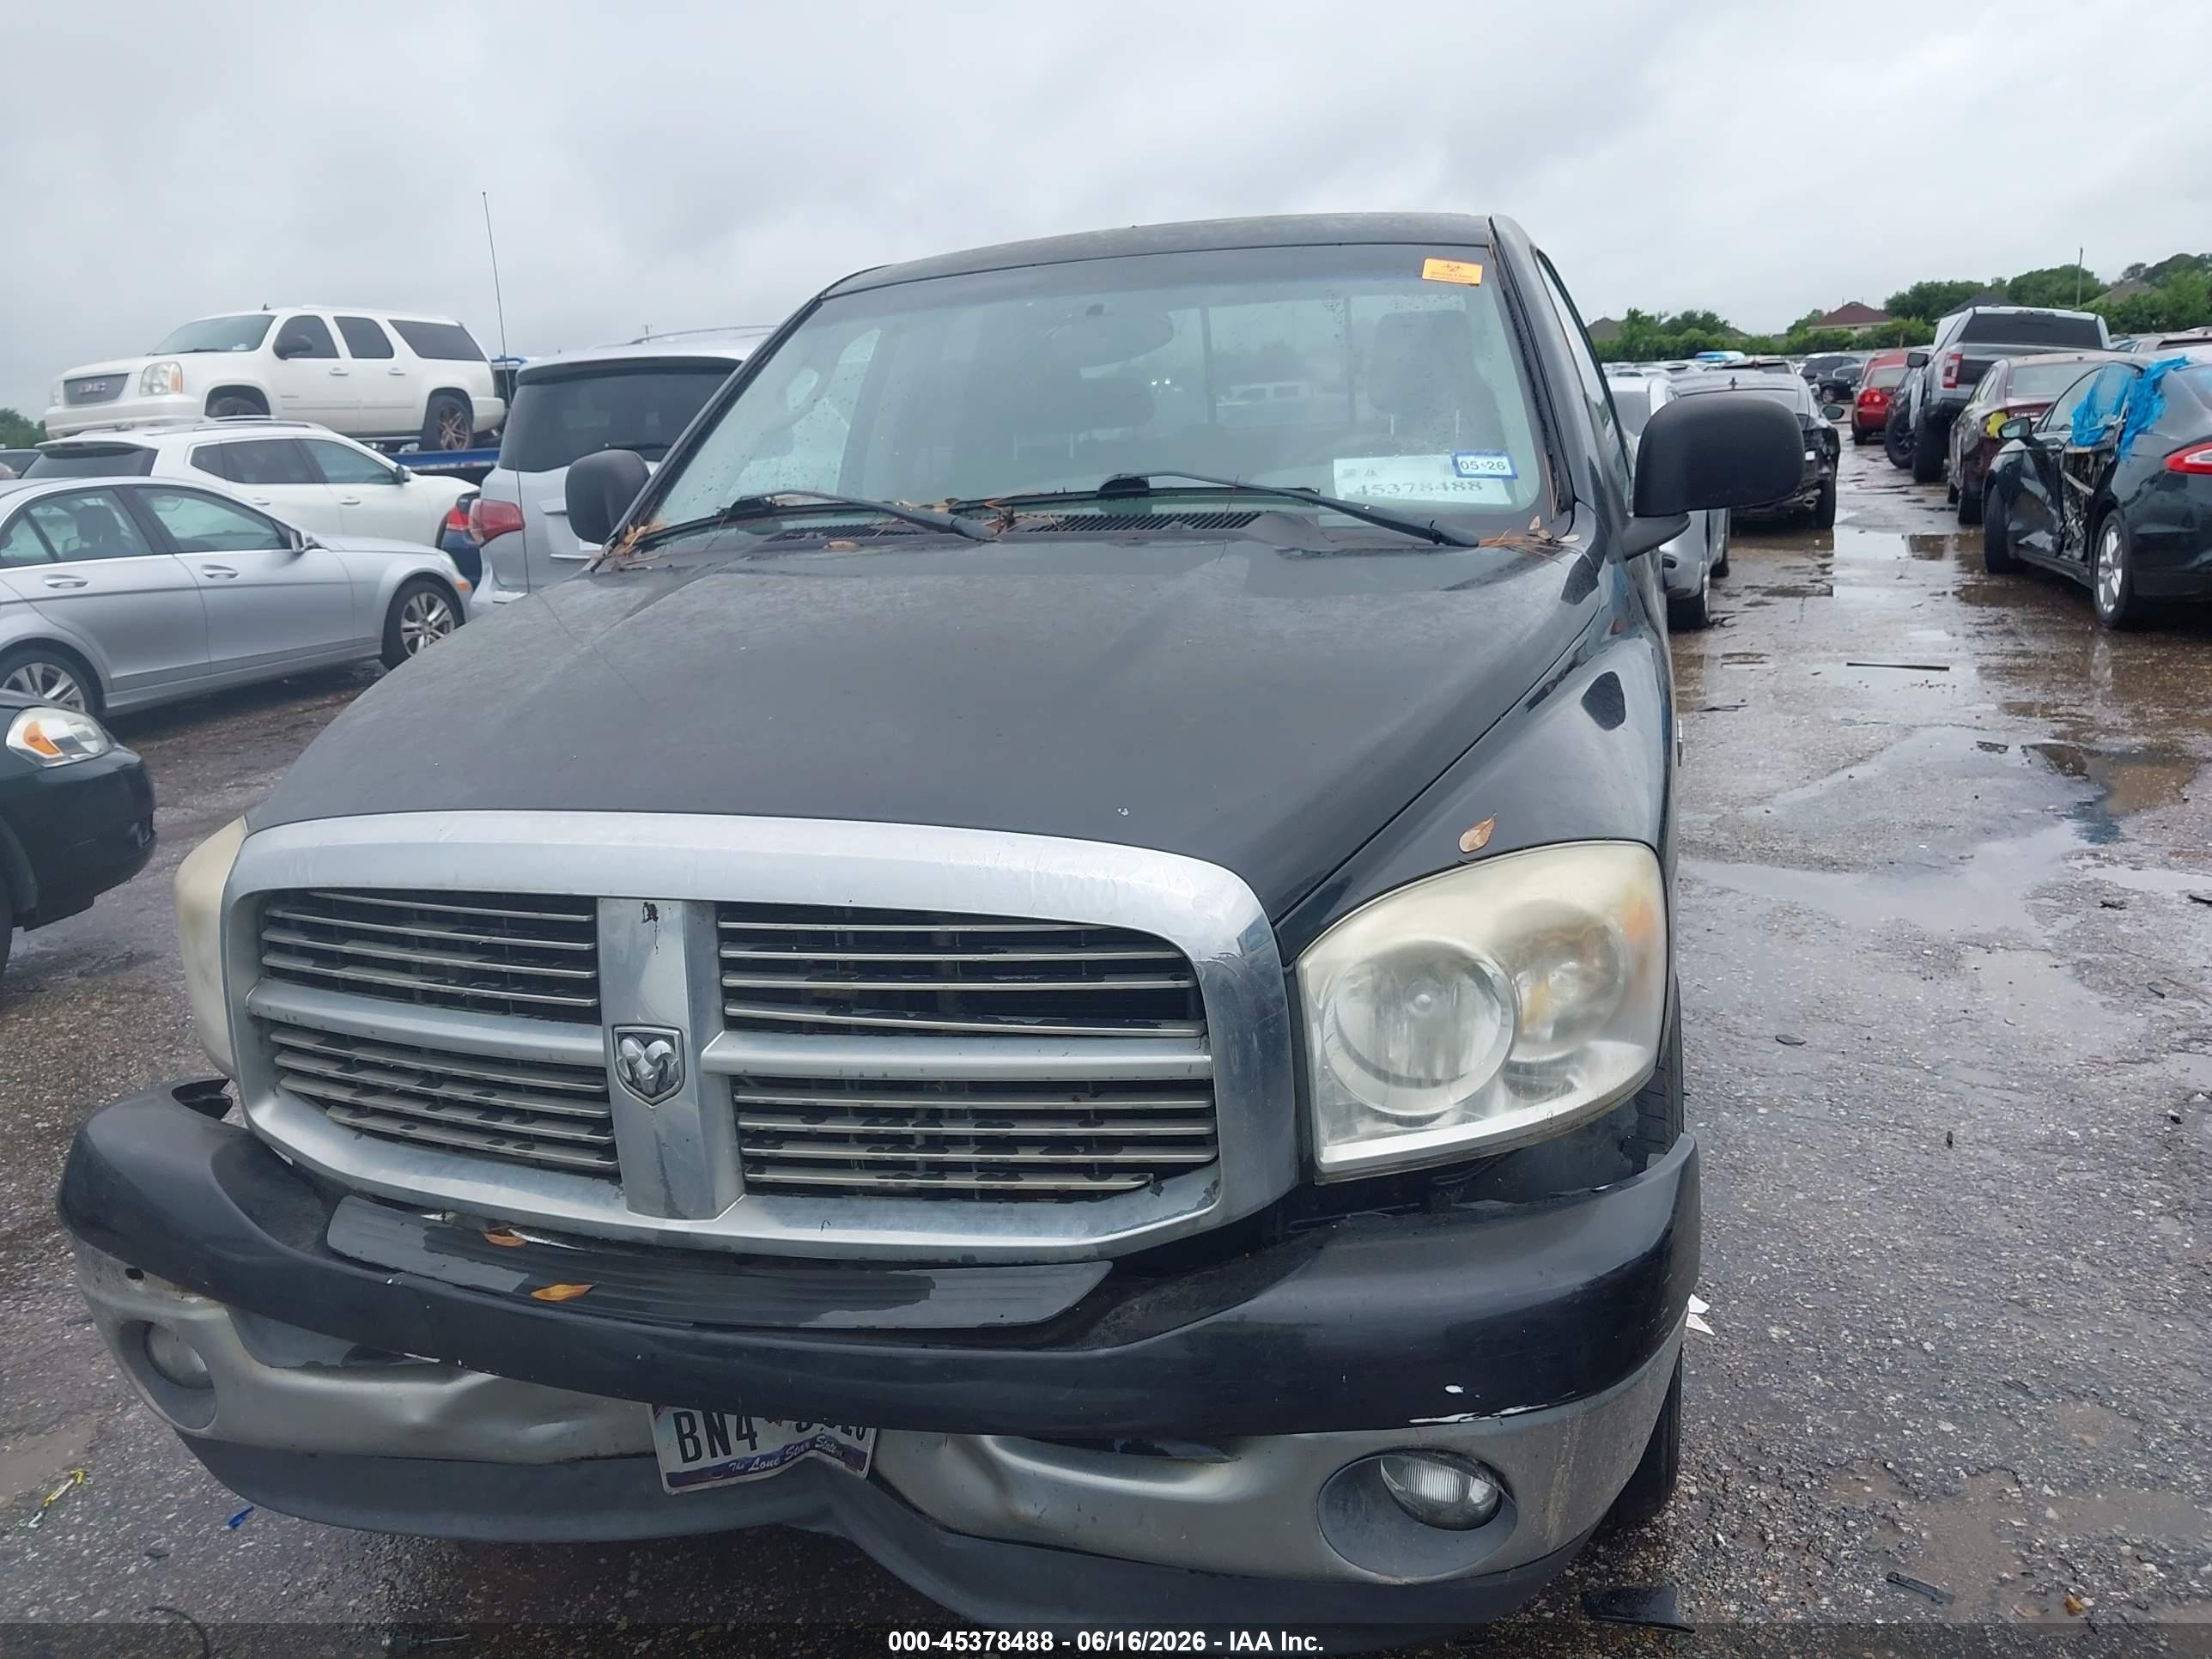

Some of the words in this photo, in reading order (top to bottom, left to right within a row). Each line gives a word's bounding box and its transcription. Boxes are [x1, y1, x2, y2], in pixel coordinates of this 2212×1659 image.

[1354, 480, 1484, 495] 45378488
[728, 1462, 745, 1472] The
[747, 1457, 780, 1473] Lone
[785, 1442, 811, 1462] Star
[814, 1435, 838, 1455] State
